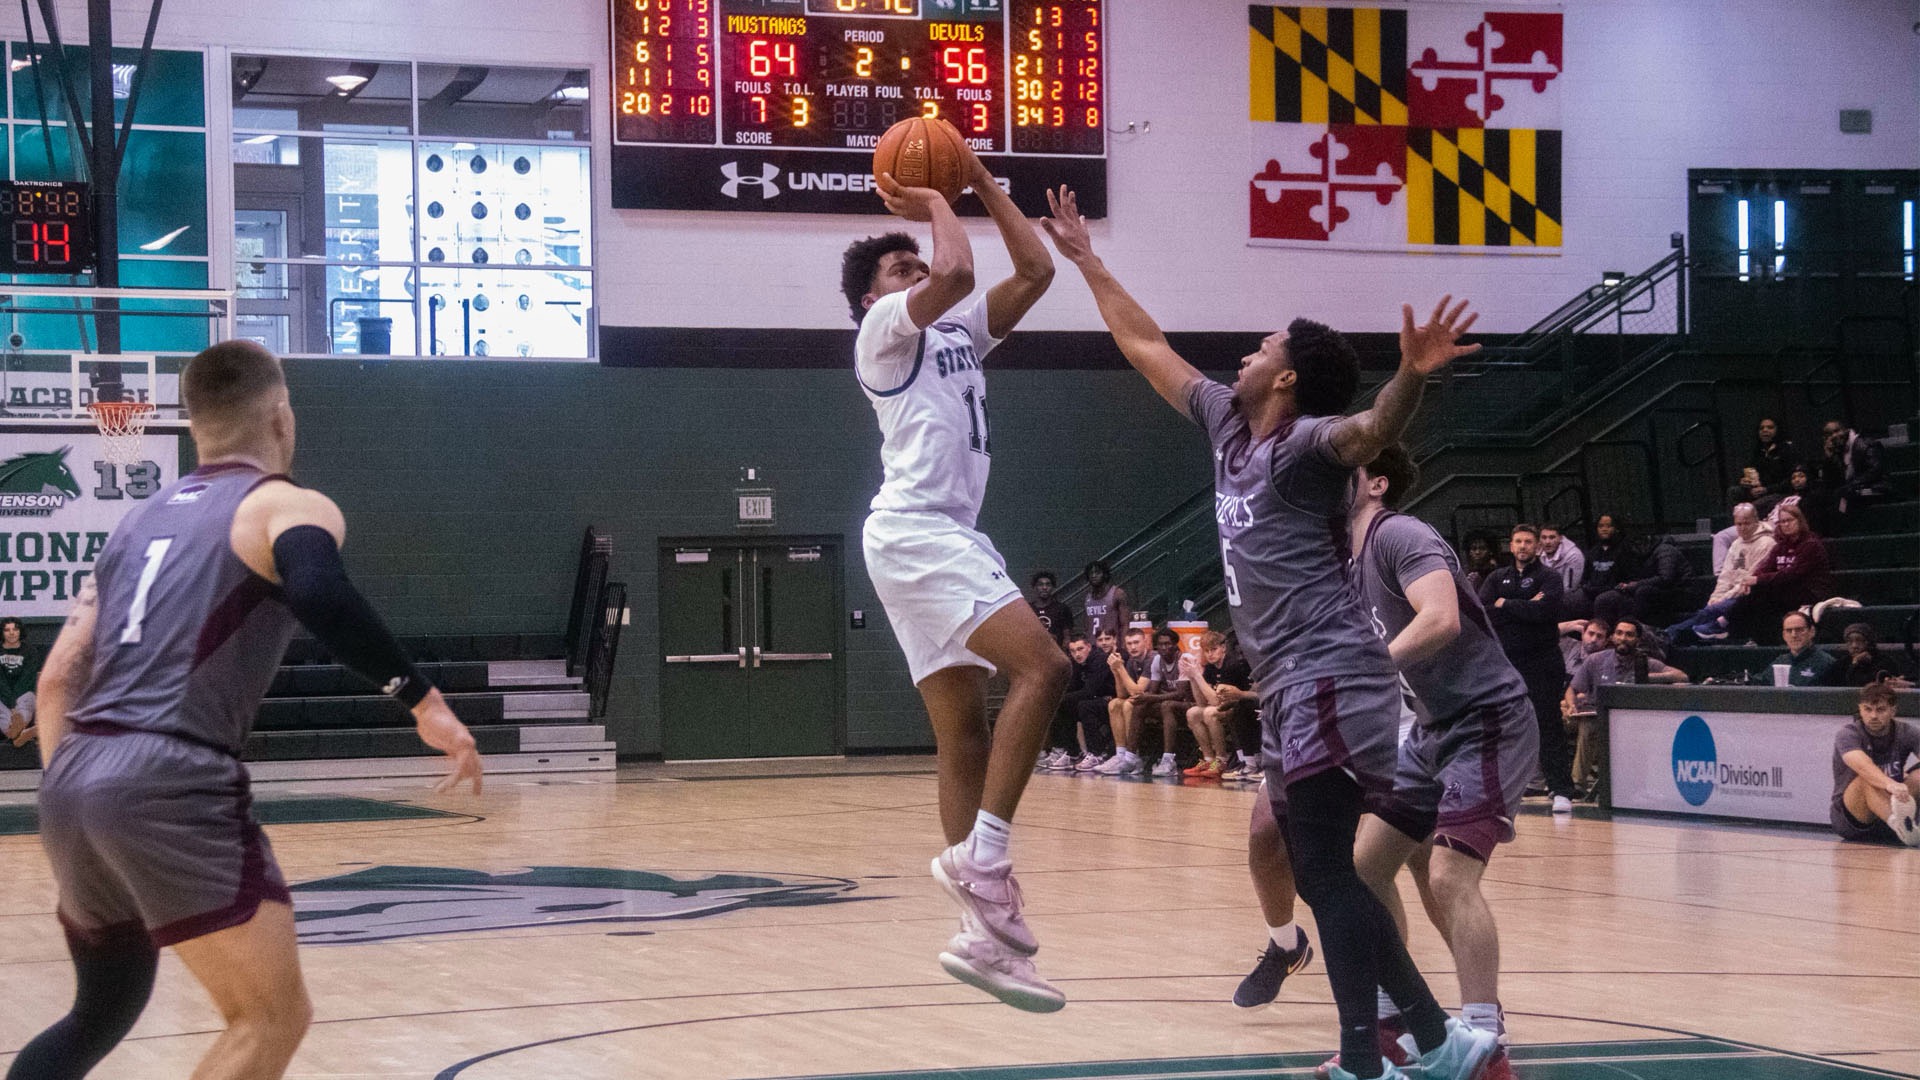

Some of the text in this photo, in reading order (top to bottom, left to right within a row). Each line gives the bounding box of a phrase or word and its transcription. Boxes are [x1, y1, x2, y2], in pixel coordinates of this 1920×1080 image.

[659, 16, 671, 36] 2
[697, 17, 709, 38] 3
[728, 15, 807, 36] MUSTANGS
[1051, 6, 1063, 27] 3
[1086, 7, 1098, 26] 7
[844, 30, 885, 43] PERIOD
[930, 23, 985, 42] DEVILS
[1028, 29, 1043, 51] 5
[1085, 31, 1098, 52] 5
[636, 41, 650, 62] 6
[697, 44, 709, 64] 5
[750, 41, 796, 77] 64
[856, 48, 873, 77] 2
[943, 48, 988, 83] 56
[1015, 54, 1043, 76] 21
[1079, 57, 1098, 78] 12
[629, 67, 650, 85] 11
[697, 69, 710, 88] 9
[735, 81, 772, 95] FOULS
[784, 83, 815, 96] T.O.L.
[826, 84, 904, 99] PLAYER FOUL
[914, 86, 945, 100] T.O.L.
[957, 88, 992, 101] FOULS
[1017, 79, 1098, 102] 30 2 12
[622, 92, 710, 116] 20 2 10
[751, 97, 767, 123] 7
[792, 97, 809, 127] 3
[973, 104, 988, 132] 3
[1017, 105, 1098, 128] 34 3 8
[736, 131, 772, 145] SCORE
[846, 135, 880, 147] MATC
[965, 138, 994, 150] CORE
[32, 223, 70, 262] 14
[338, 174, 363, 354] INTEGRITY
[962, 386, 992, 457] 11
[94, 461, 162, 499] 13
[0, 495, 63, 507] ENSON
[745, 499, 768, 516] EXIT
[0, 509, 53, 517] IVERSITY
[1222, 538, 1242, 607] 5
[120, 536, 176, 645] 1
[1677, 759, 1717, 784] NCAA
[1720, 763, 1783, 788] Division III
